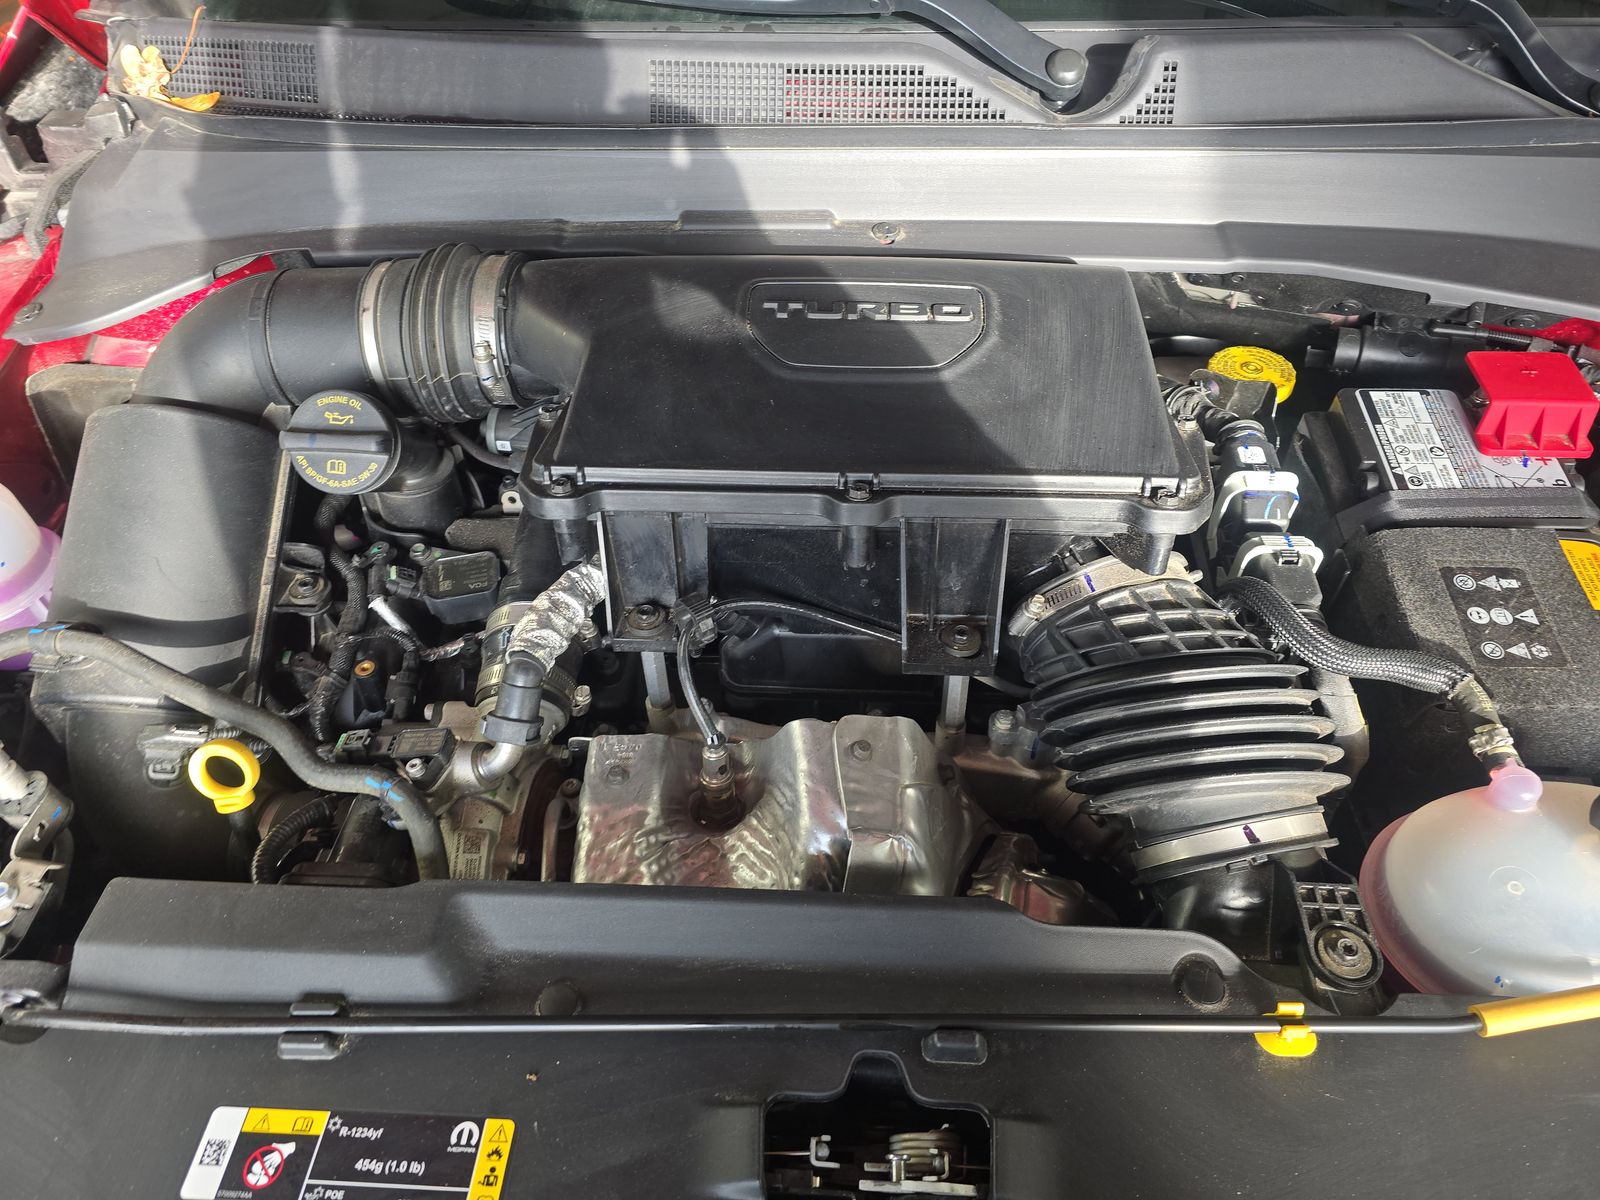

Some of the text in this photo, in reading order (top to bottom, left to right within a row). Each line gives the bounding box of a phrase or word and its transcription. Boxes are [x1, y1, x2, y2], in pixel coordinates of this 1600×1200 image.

[762, 301, 976, 321] TURBO
[317, 395, 362, 410] ENGINE OIL
[296, 455, 306, 469] API
[358, 462, 378, 482] 5W-30
[339, 1126, 384, 1141] R-1234yf
[354, 1158, 426, 1176] 454g (1.0 lb)
[325, 1189, 345, 1200] POE
